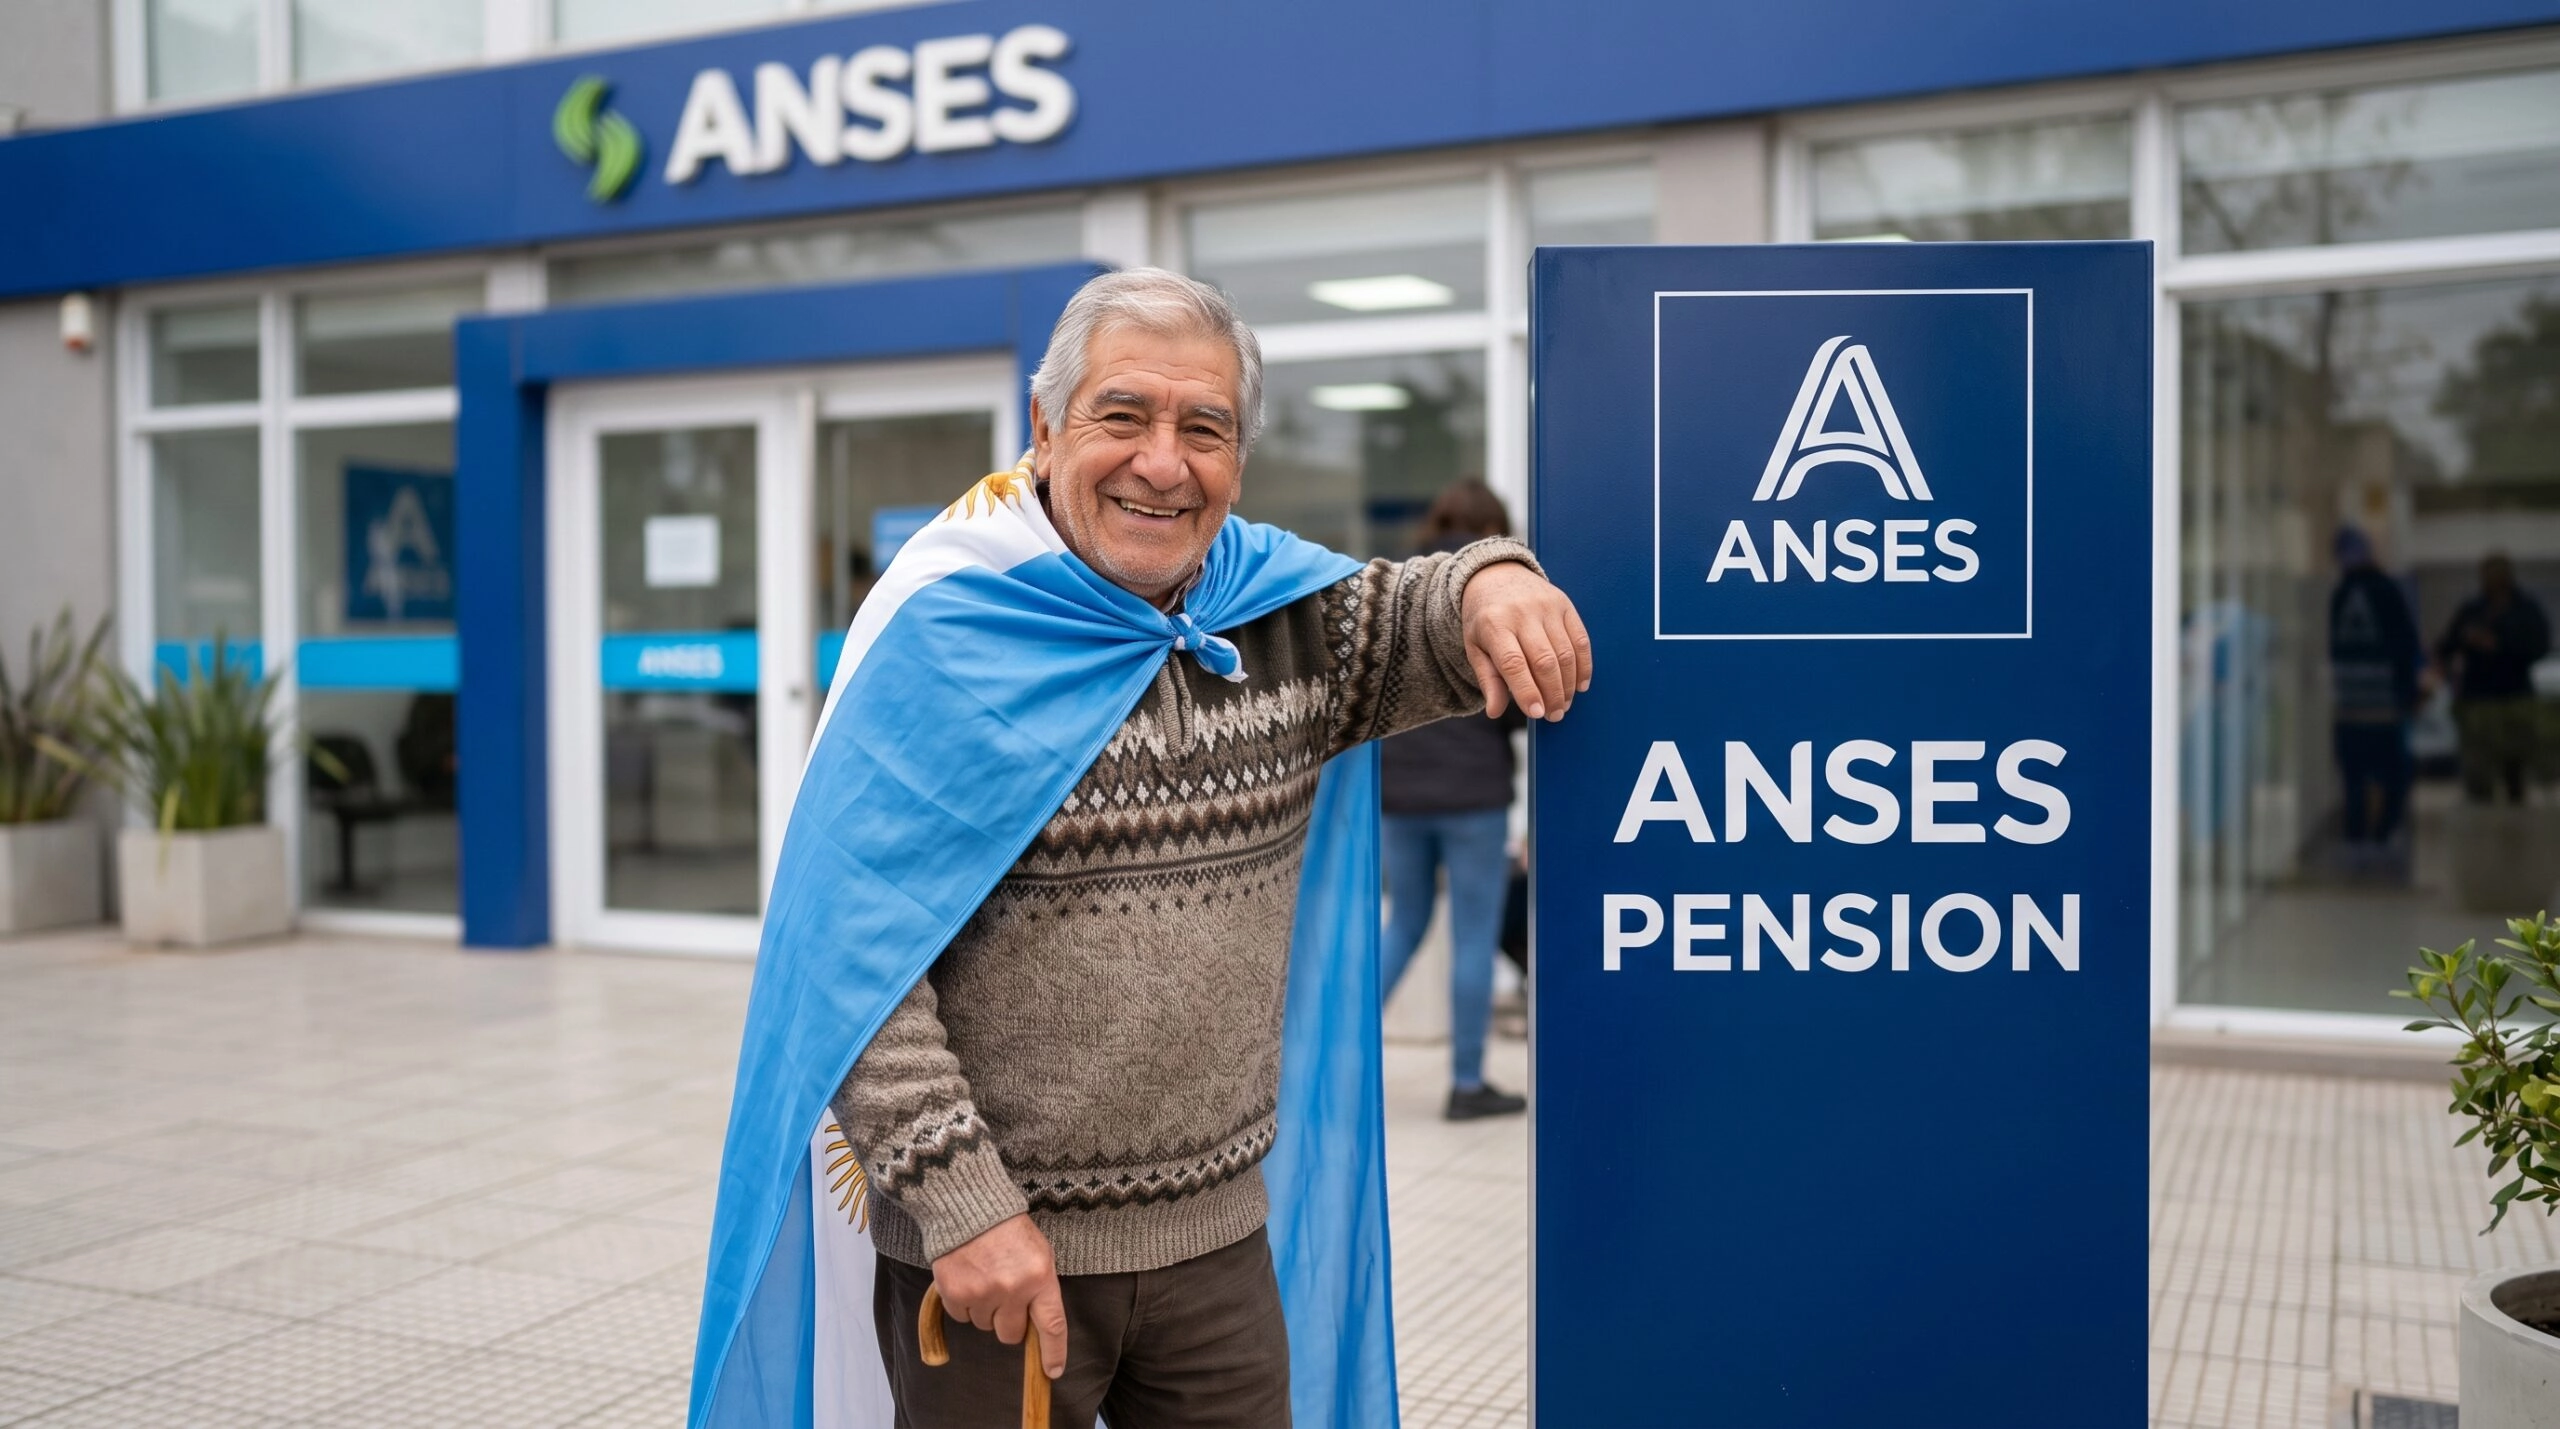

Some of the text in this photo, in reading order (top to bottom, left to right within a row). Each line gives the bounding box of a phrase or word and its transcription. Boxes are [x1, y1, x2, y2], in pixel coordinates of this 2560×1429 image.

[664, 24, 1076, 184] ANSES
[1706, 518, 1980, 583] ANSES
[1613, 739, 2072, 845] ANSES
[1603, 892, 2081, 973] PENSION
